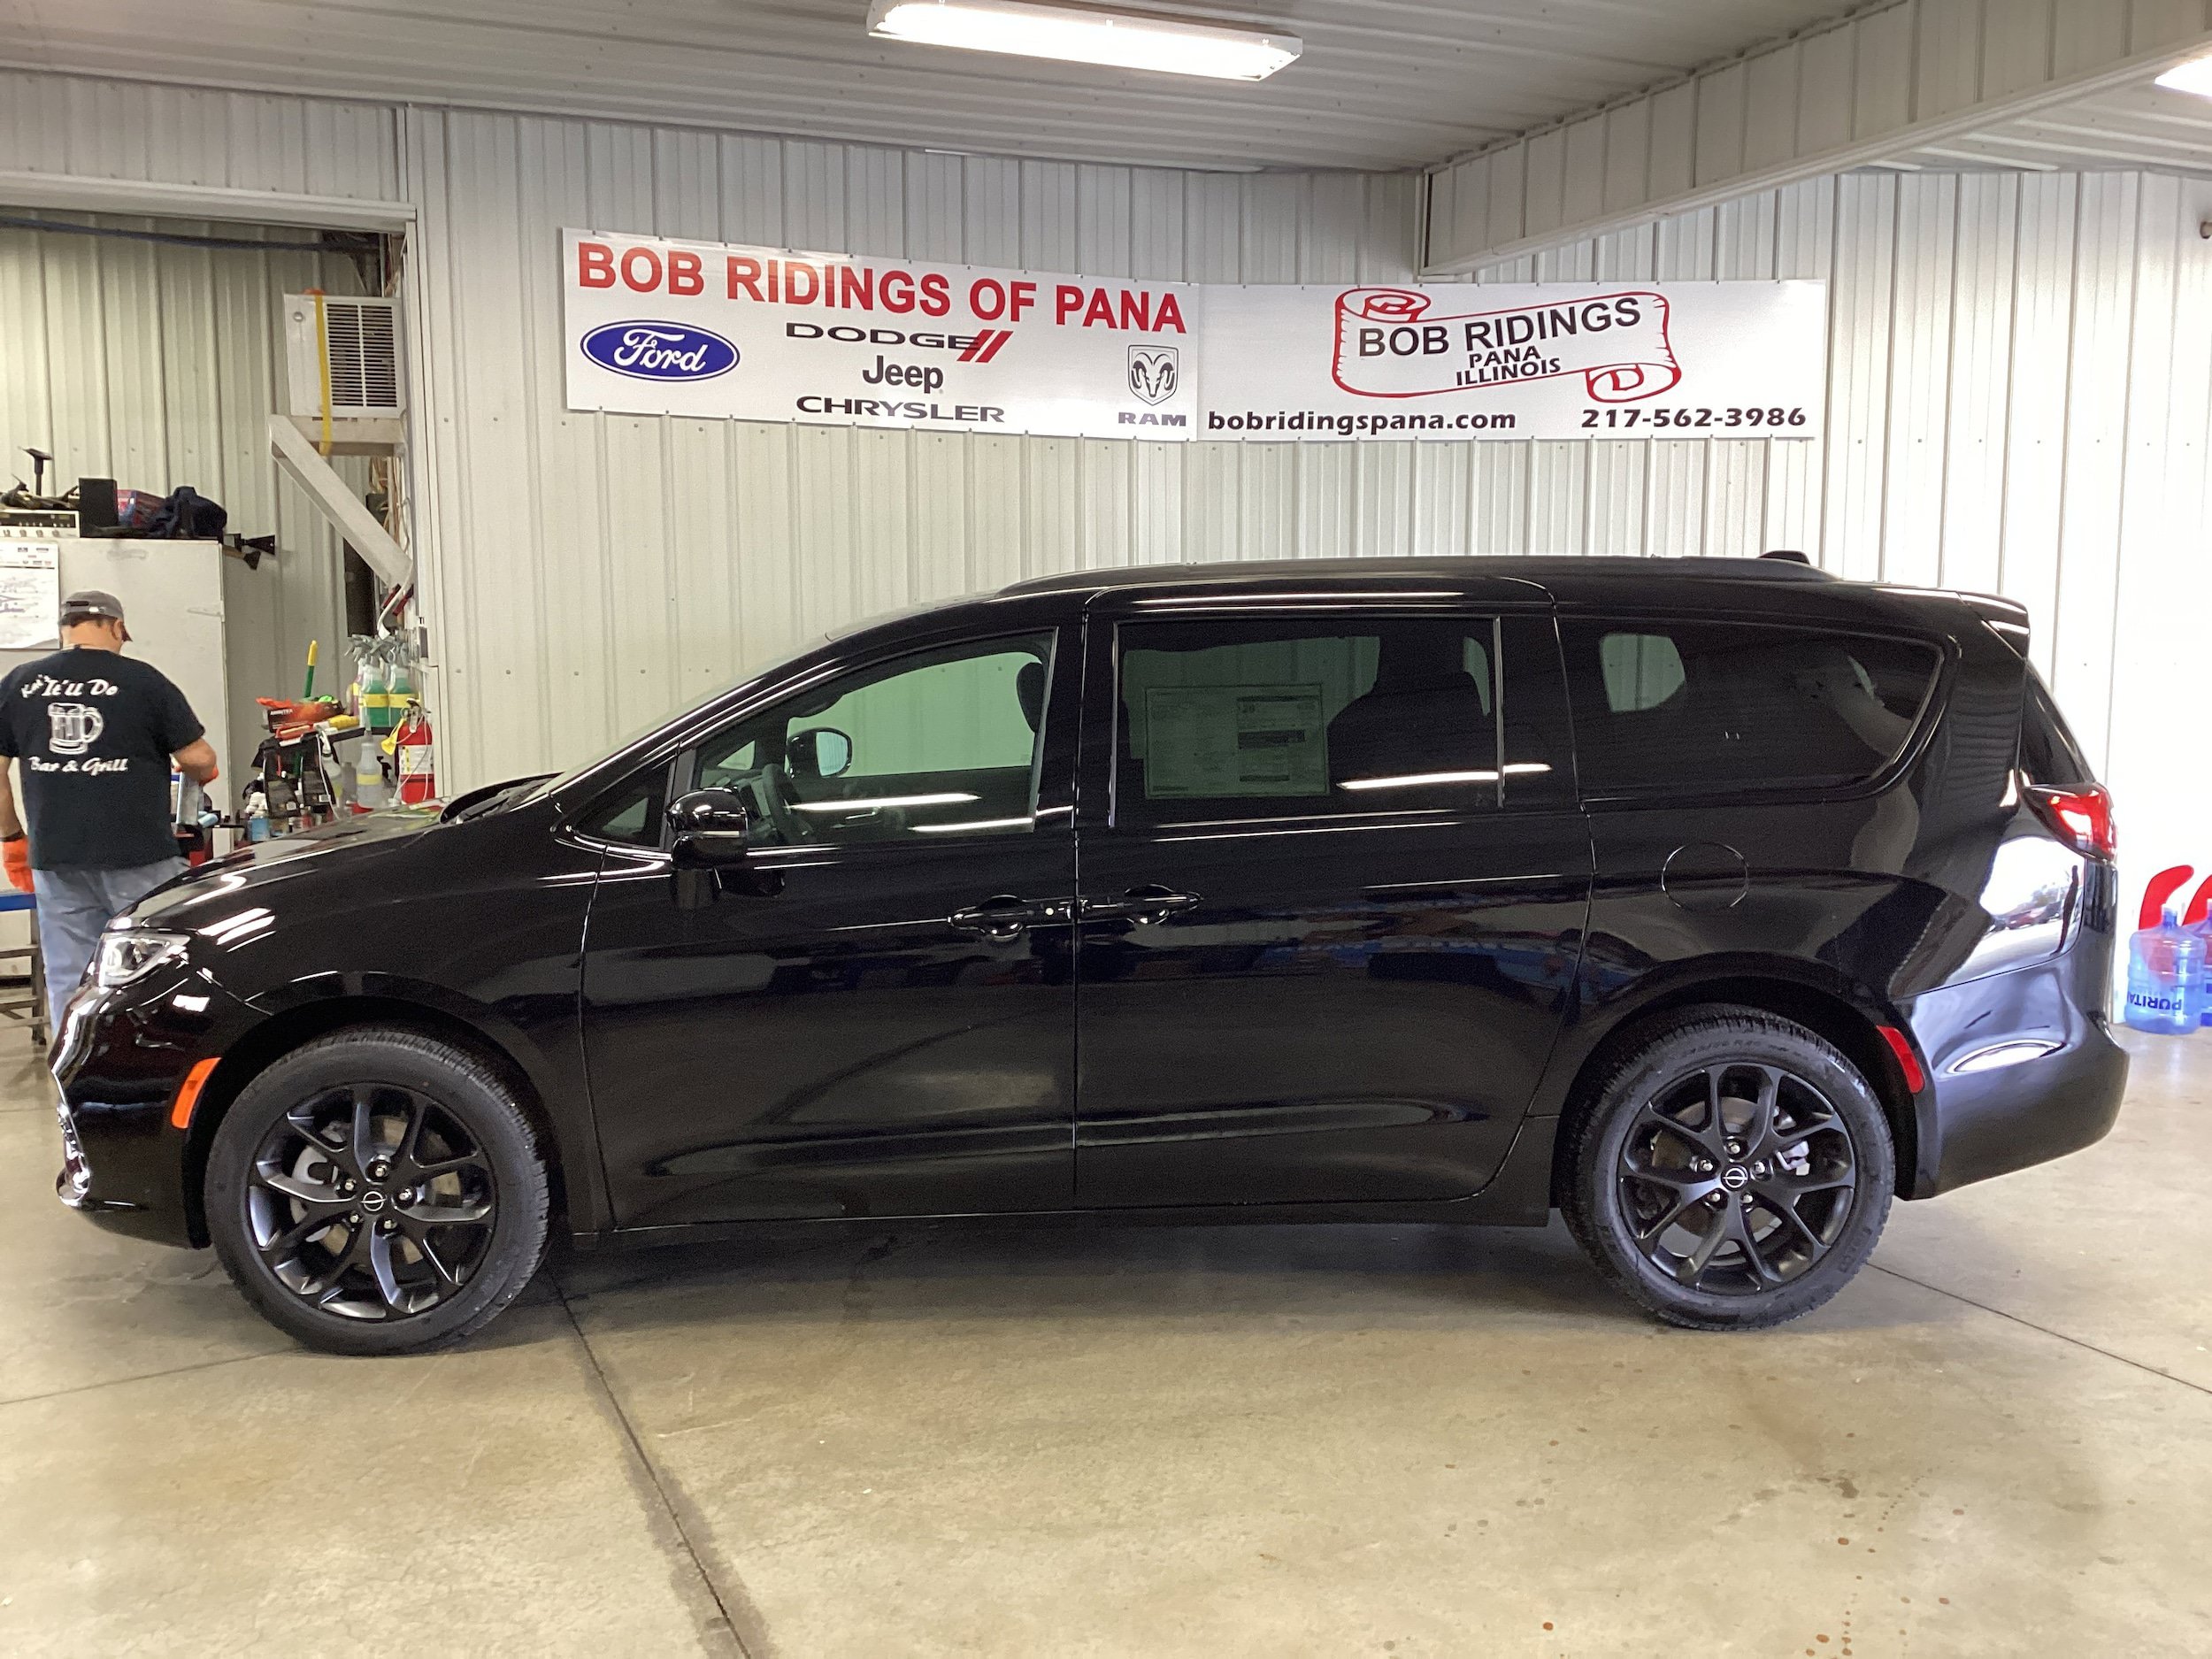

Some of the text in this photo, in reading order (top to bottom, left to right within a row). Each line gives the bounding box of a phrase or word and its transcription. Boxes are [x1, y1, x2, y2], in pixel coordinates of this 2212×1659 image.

[578, 241, 1187, 334] BOB RIDINGS OF PANA
[786, 322, 981, 350] DODGE
[1359, 296, 1641, 357] BOB RIDINGS
[613, 328, 709, 373] Ford
[1469, 344, 1542, 368] PANA
[862, 355, 944, 395] Jeep
[1455, 357, 1562, 386] ILLINOIS
[796, 396, 1005, 423] CHRYSLER
[1118, 411, 1187, 426] RAM
[1581, 407, 1807, 428] 217-562-3986
[1208, 411, 1517, 436] bobridingspana.com
[87, 678, 119, 696] Do
[28, 756, 129, 777] Bar & Grill
